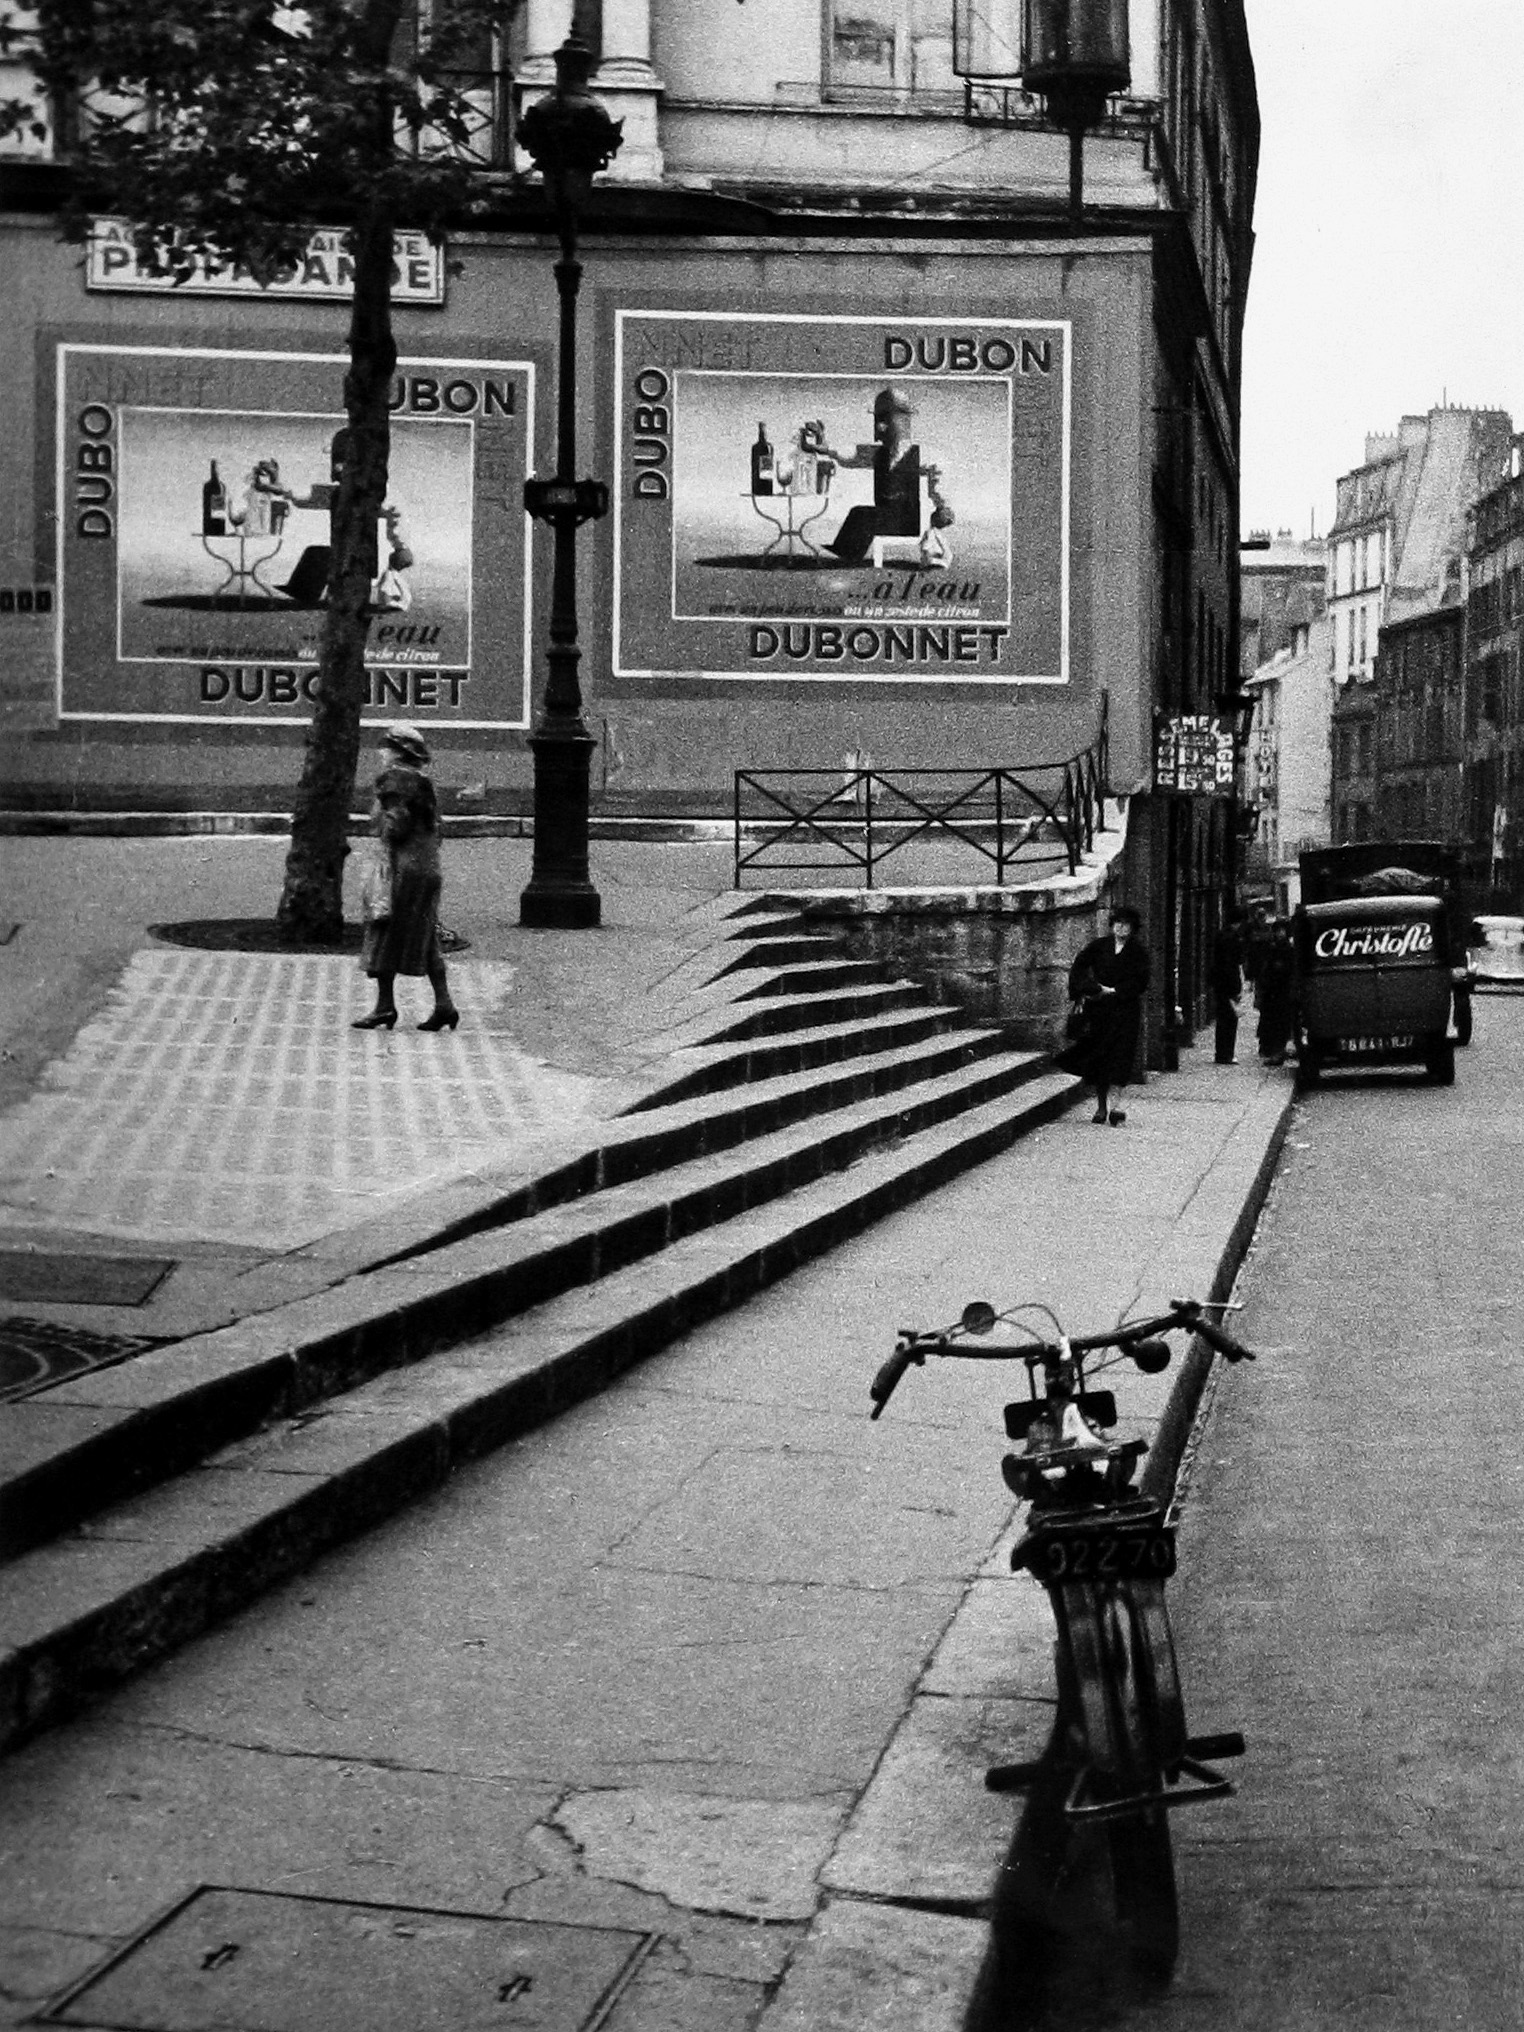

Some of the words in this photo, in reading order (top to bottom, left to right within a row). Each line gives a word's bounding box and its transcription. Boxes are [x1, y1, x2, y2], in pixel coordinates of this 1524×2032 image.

[885, 337, 1050, 374] DUBON
[388, 376, 514, 417] UBON
[634, 367, 670, 499] DUBO
[75, 403, 114, 538] DUBO
[937, 606, 980, 618] citron
[750, 624, 1010, 663] DUBONNET
[201, 666, 470, 708] DUBONET
[1315, 922, 1433, 957] Christofle
